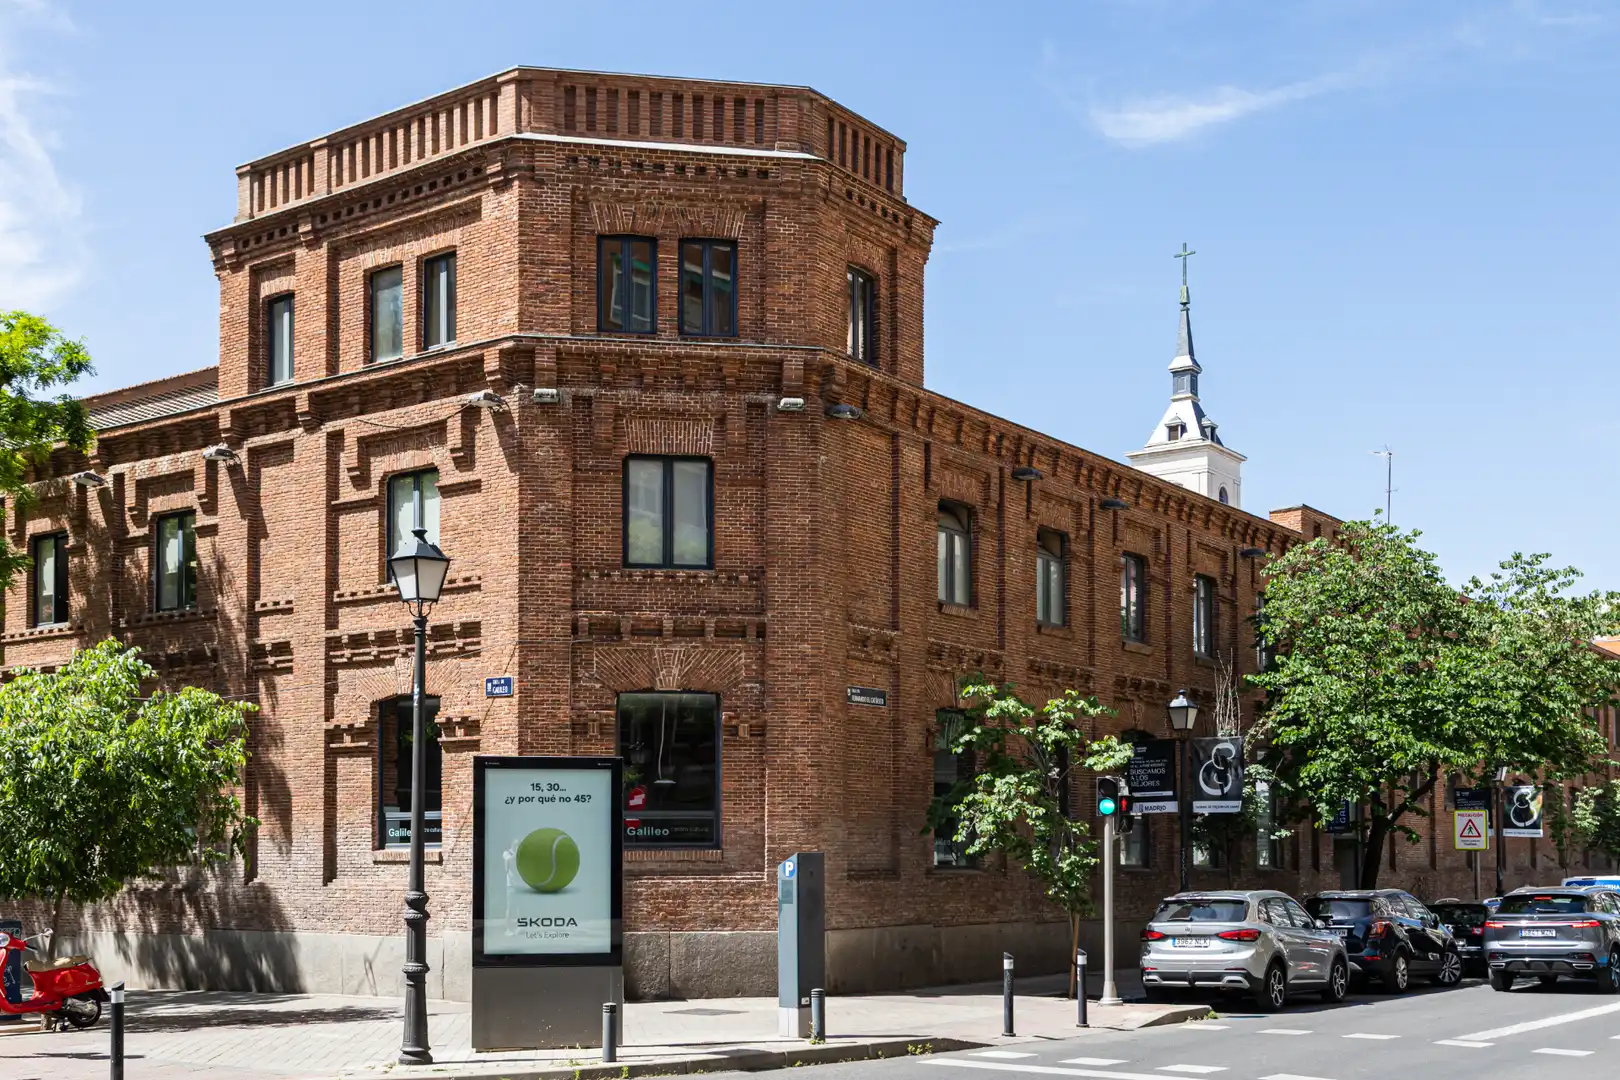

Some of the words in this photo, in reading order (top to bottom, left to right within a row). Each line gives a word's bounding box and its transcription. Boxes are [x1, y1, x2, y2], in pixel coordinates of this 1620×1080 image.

[1130, 767, 1166, 775] BUSCAMOS
[530, 782, 544, 792] 15,
[546, 782, 567, 792] 30...
[504, 796, 515, 805] ¿y
[537, 794, 556, 804] qué
[574, 794, 592, 803] 45?
[1144, 804, 1167, 812] MADRID
[388, 827, 412, 837] Galile
[626, 826, 670, 836] Galileo
[785, 861, 794, 877] P
[525, 931, 543, 939] Let's
[543, 931, 570, 939] Explore
